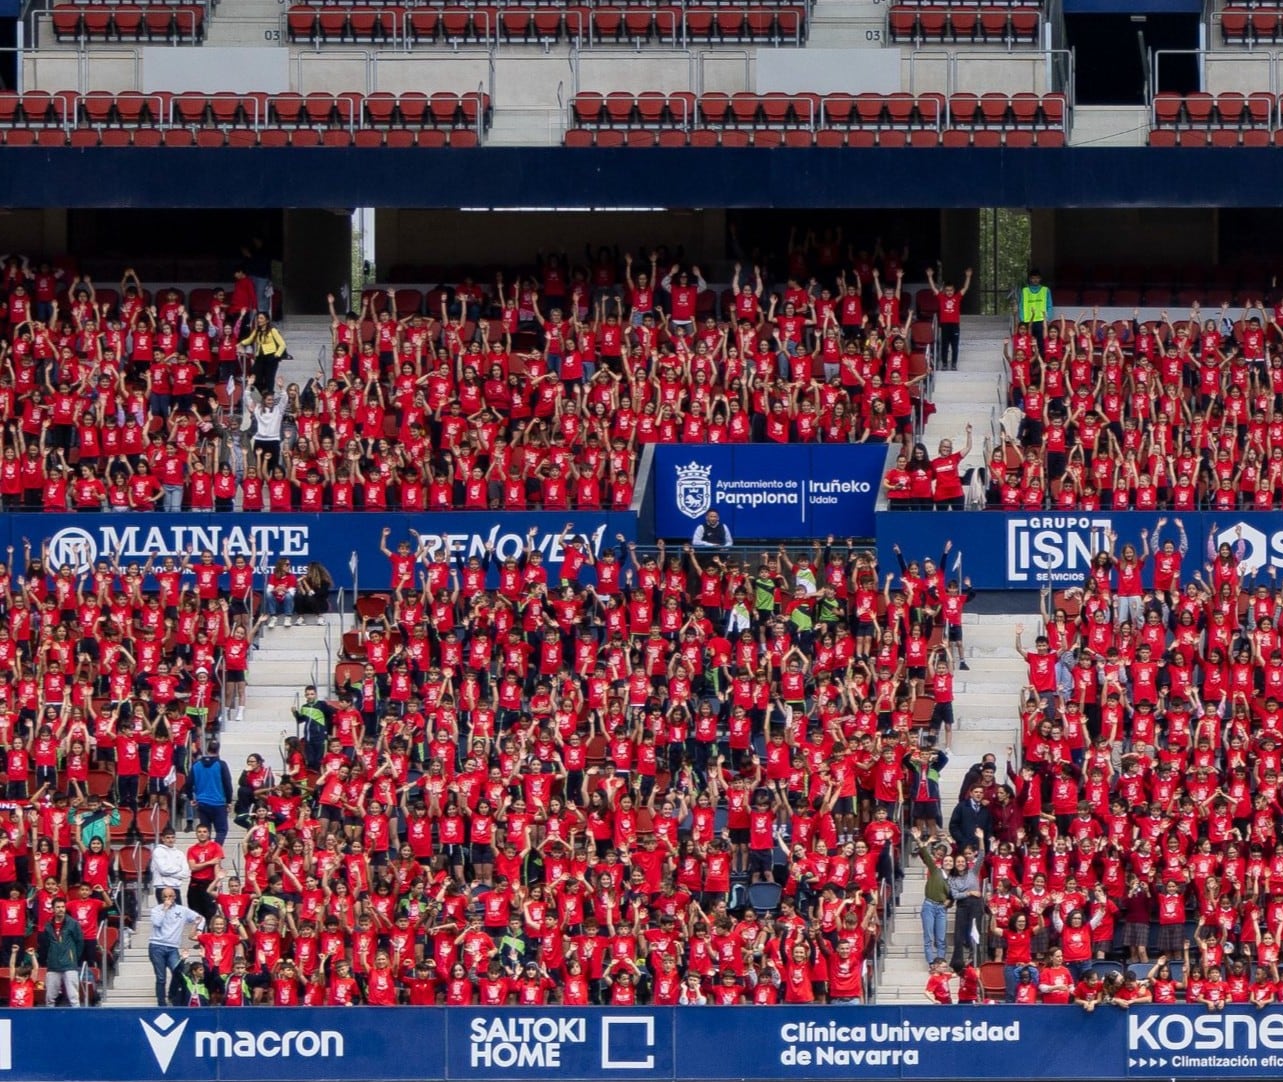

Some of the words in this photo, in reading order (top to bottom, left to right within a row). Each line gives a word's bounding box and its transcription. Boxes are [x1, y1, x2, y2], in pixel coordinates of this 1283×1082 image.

[264, 30, 280, 41] 03
[865, 30, 881, 41] 03
[716, 480, 783, 489] Ayuntamiento
[785, 480, 798, 488] de
[809, 479, 870, 493] Iruñeko
[716, 491, 798, 508] Pamplona
[809, 495, 838, 504] Udala
[1029, 517, 1090, 529] GRUPO
[99, 526, 309, 556] MAINATE
[1020, 530, 1099, 569] ISN
[470, 1017, 586, 1043] SALTOKI
[780, 1021, 866, 1042] Clínica
[870, 1020, 1020, 1042] Universidad
[195, 1030, 343, 1058] macron
[471, 1042, 561, 1067] HOME
[780, 1045, 812, 1066] de
[816, 1047, 919, 1066] Navarra
[1171, 1055, 1257, 1067] Climatización
